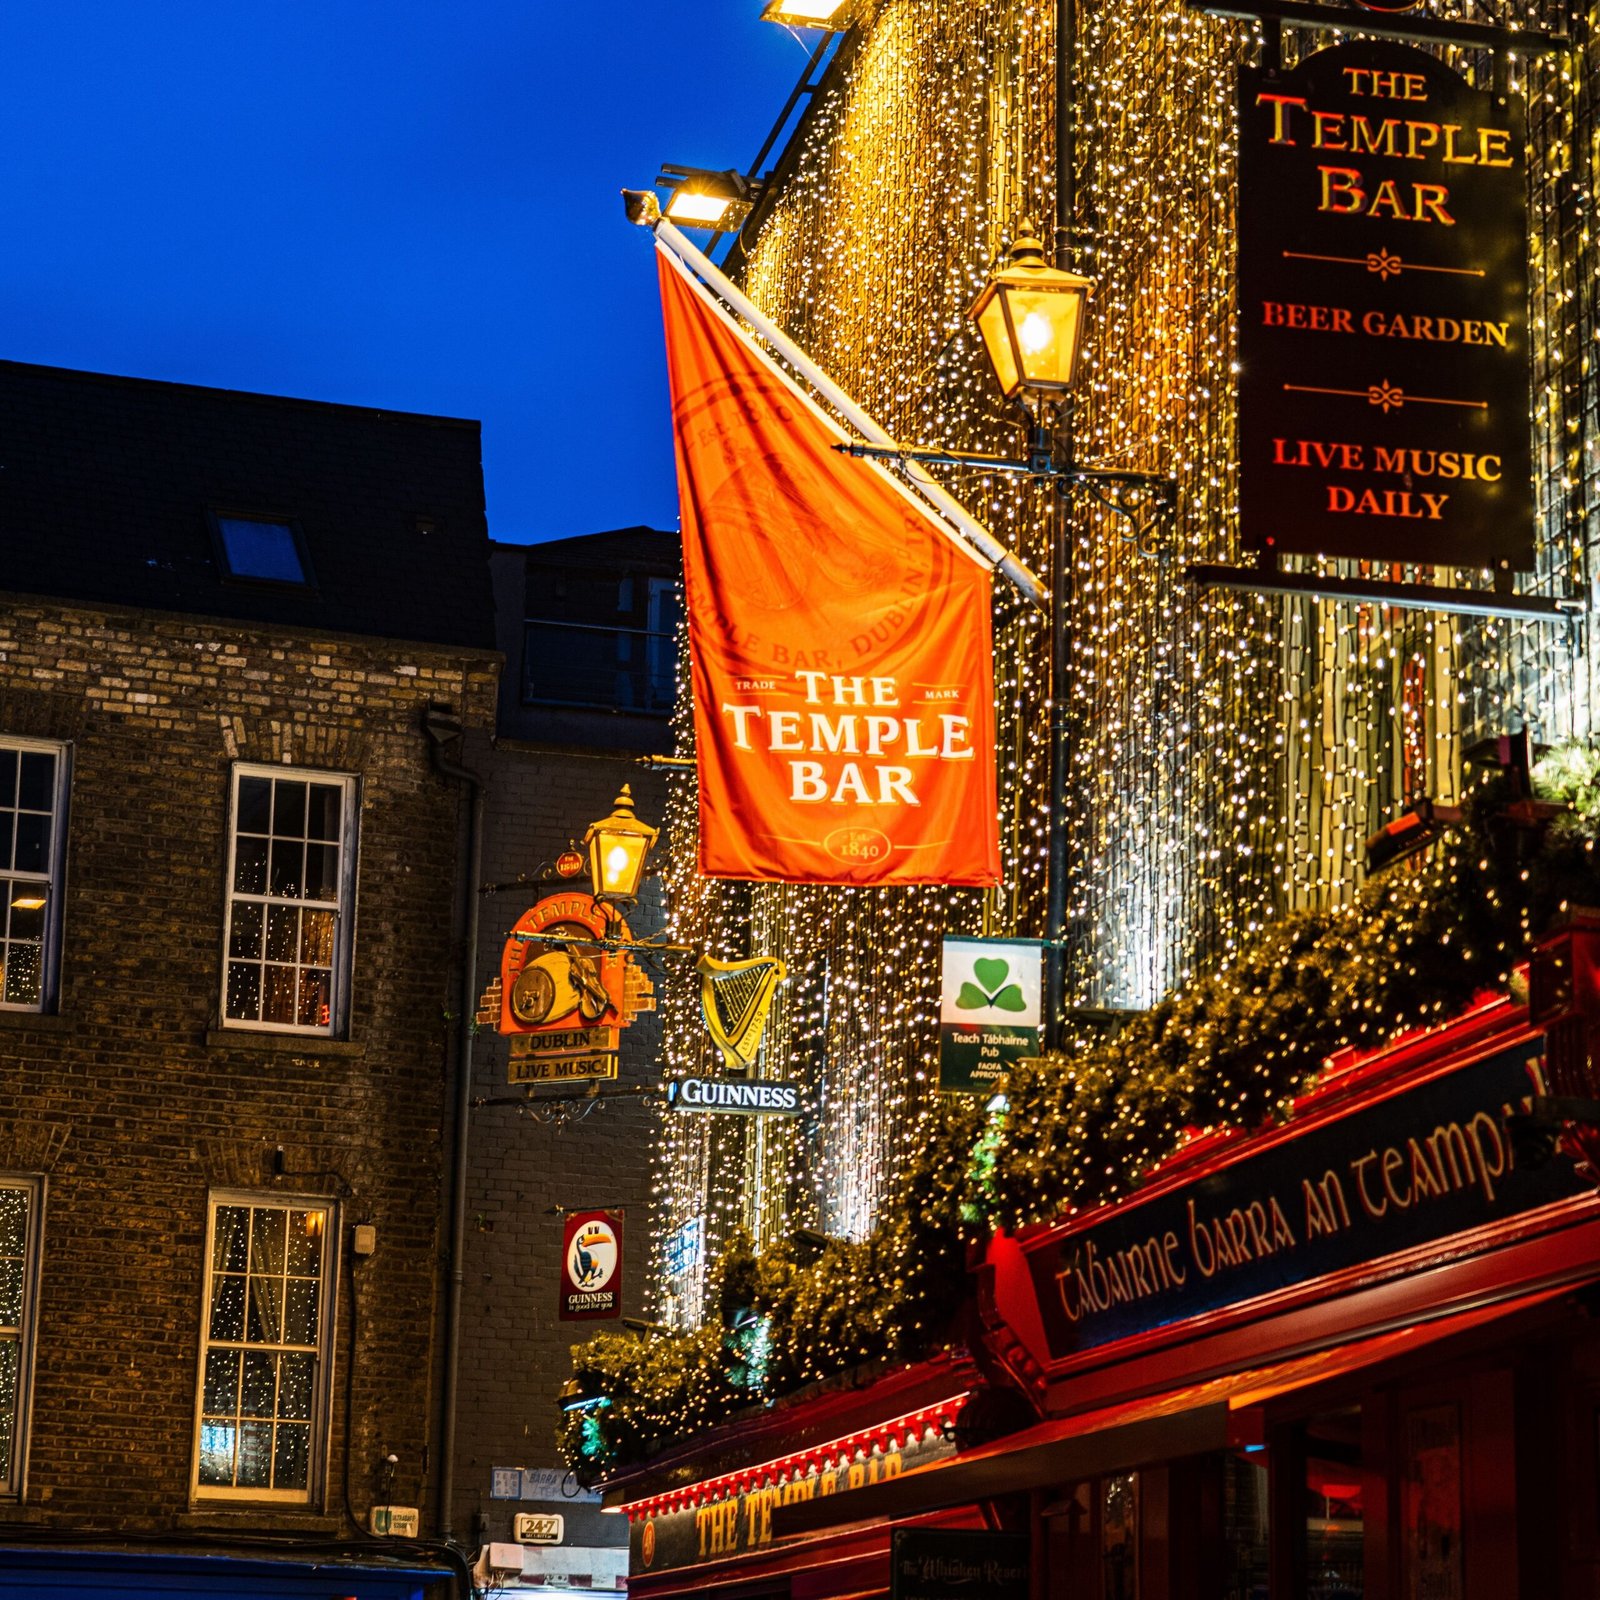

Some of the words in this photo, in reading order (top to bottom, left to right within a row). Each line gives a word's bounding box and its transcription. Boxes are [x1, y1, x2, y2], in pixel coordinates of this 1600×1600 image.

[1343, 67, 1428, 101] THE
[1256, 93, 1514, 168] TEMPLE
[1317, 165, 1455, 225] BAR
[1262, 301, 1355, 333] BEER
[1362, 311, 1510, 347] GARDEN
[1272, 438, 1363, 470] LIVE
[1373, 447, 1502, 481] MUSIC
[1326, 486, 1449, 520] DAILY
[736, 681, 776, 691] TRADE
[795, 670, 900, 706] THE
[925, 689, 959, 699] MARK
[722, 702, 975, 760] TEMPLE
[788, 760, 922, 806] BAR
[841, 841, 879, 859] 1840
[750, 1010, 764, 1033] 1759
[530, 1031, 590, 1050] DUBLIN
[952, 1032, 980, 1044] Teach
[981, 1046, 999, 1057] Pub
[516, 1064, 550, 1080] LIVE
[554, 1061, 601, 1077] MUSIC
[681, 1078, 797, 1109] GUINNESS
[568, 1292, 613, 1304] GUINNESS
[575, 1303, 590, 1312] good
[601, 1302, 613, 1310] you
[697, 1499, 738, 1556] THE
